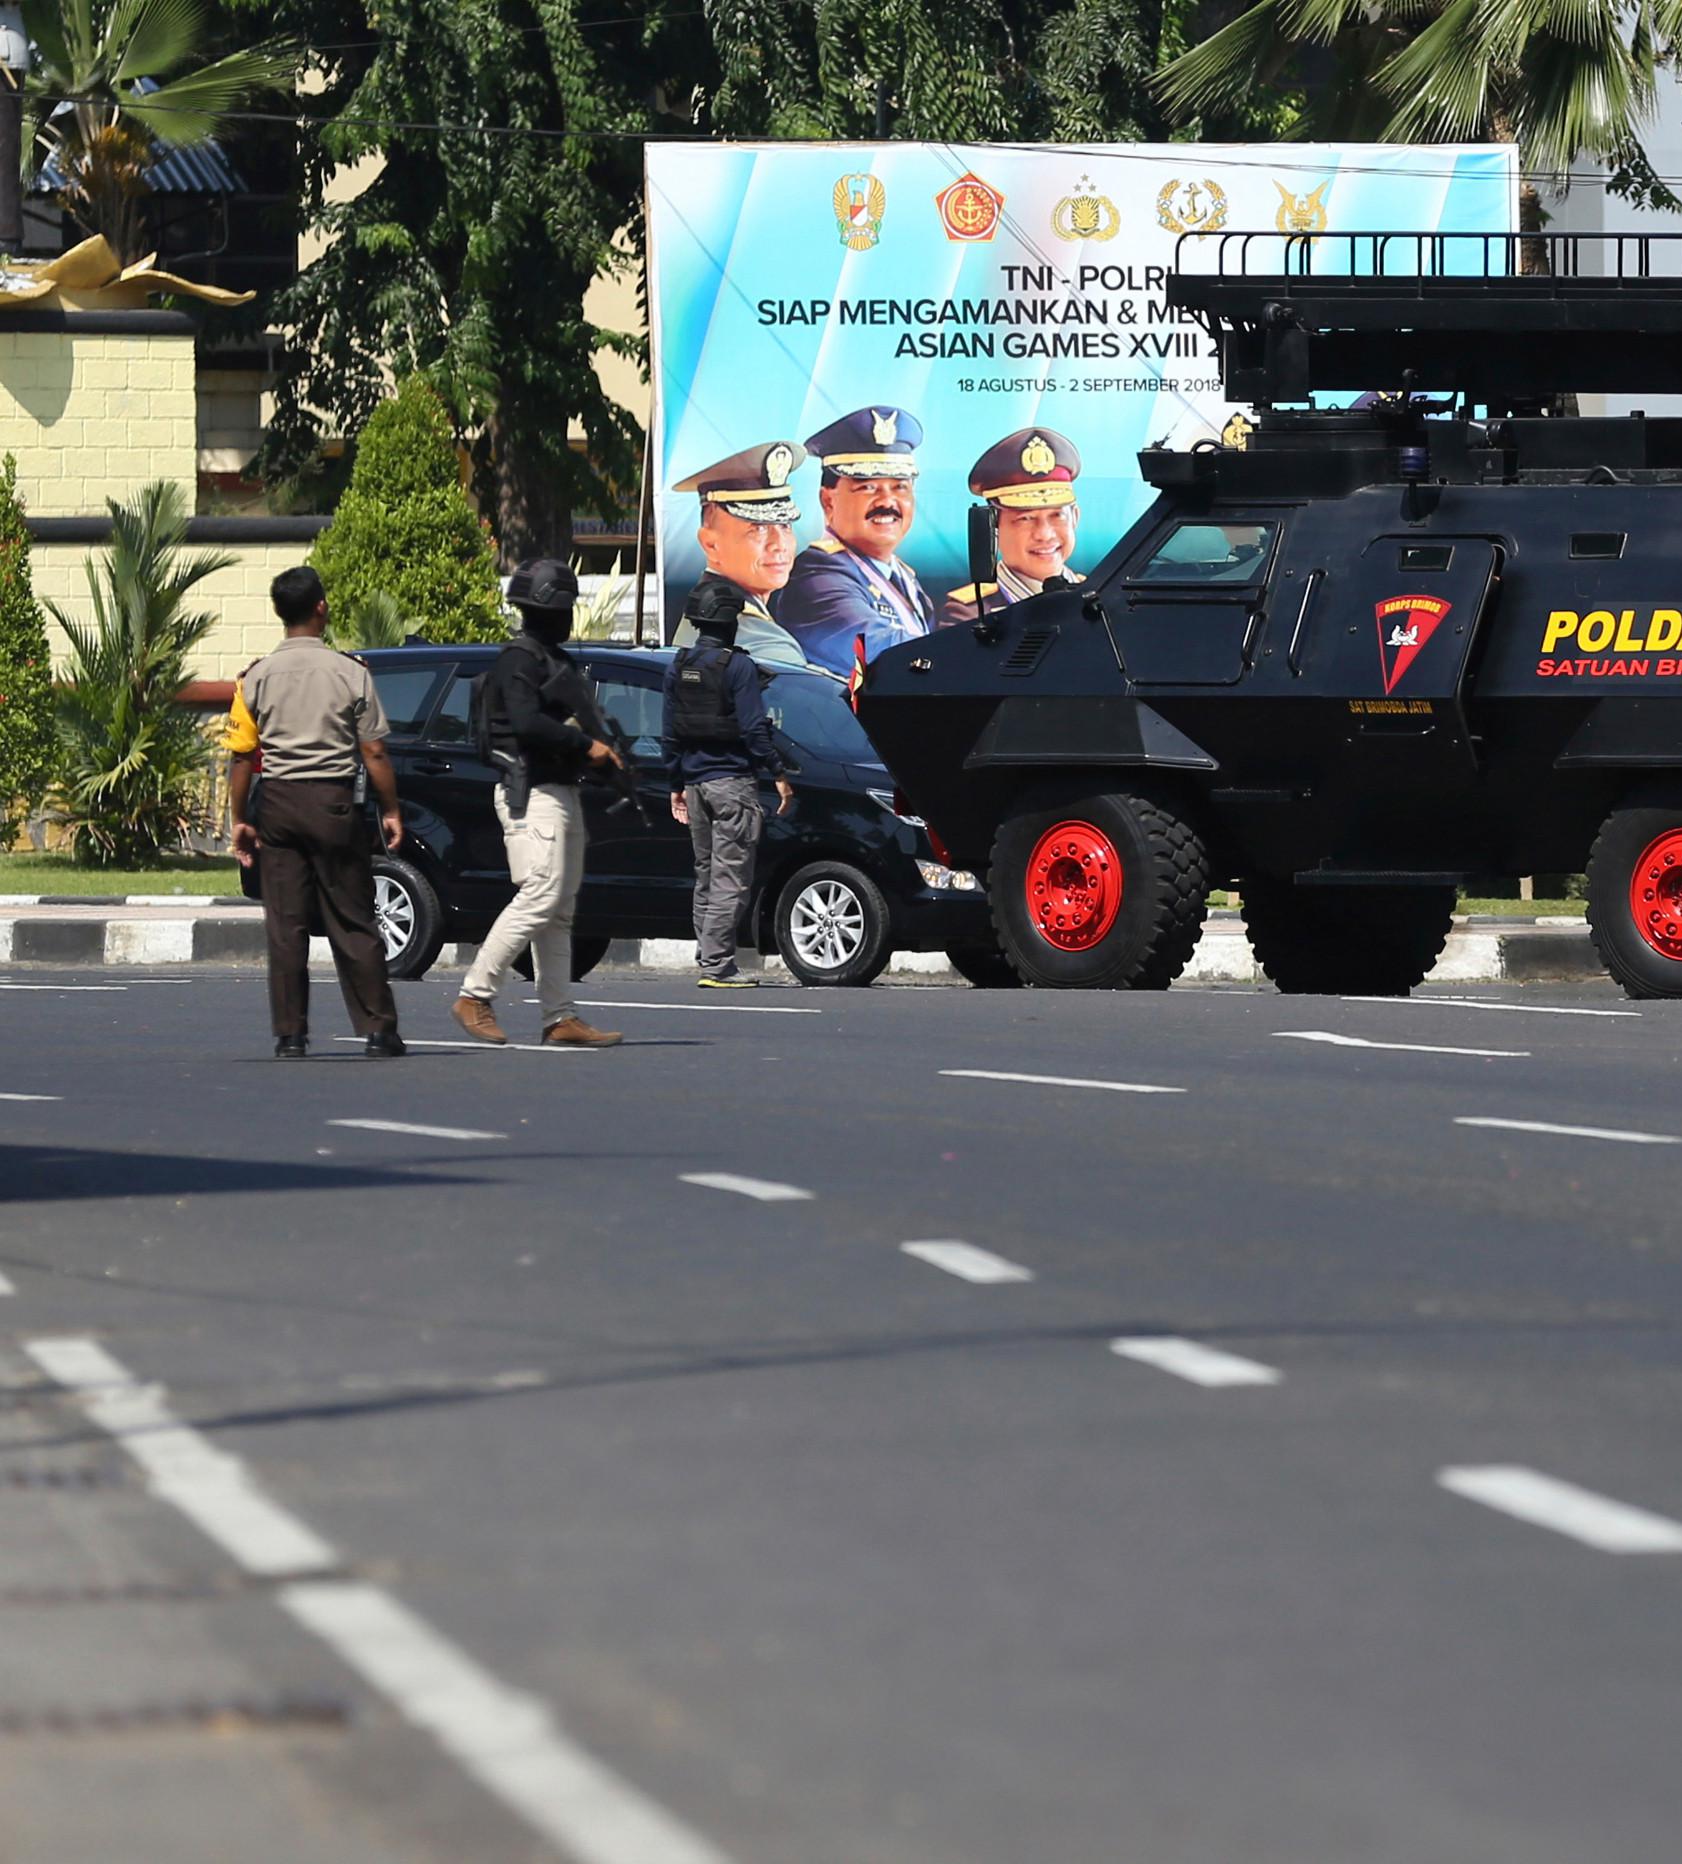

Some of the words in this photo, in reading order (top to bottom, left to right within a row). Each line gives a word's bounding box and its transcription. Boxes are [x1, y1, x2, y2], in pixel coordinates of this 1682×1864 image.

[1001, 265, 1053, 291] TNI
[757, 299, 829, 326] SIAP
[840, 299, 1108, 325] MENGAMANKAN
[1117, 299, 1138, 325] &
[895, 332, 994, 359] ASIAN
[1003, 332, 1120, 358] GAMES
[1129, 332, 1198, 358] XVIII
[958, 378, 975, 392] 18
[977, 378, 1057, 392] AGUSTUS
[1069, 378, 1079, 392] 2
[1082, 378, 1180, 392] SEPTEMBER
[1184, 378, 1221, 392] 2018
[1536, 659, 1650, 676] SATUAN
